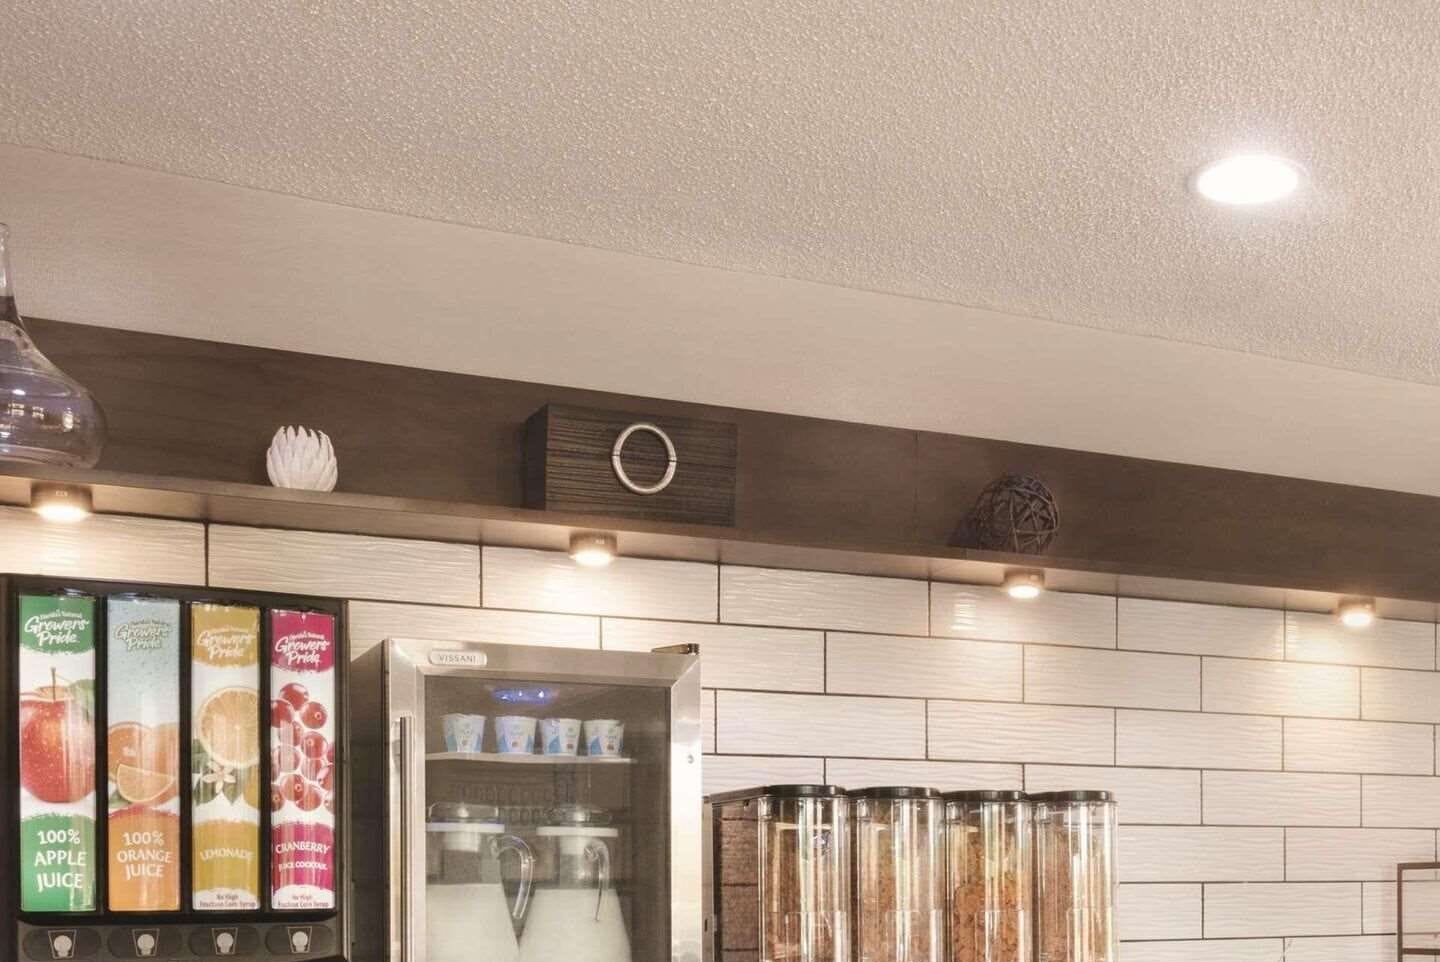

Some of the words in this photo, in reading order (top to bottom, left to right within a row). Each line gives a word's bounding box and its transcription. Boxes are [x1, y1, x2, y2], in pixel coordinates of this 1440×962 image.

[25, 616, 90, 634] Growers
[115, 623, 172, 640] Growers
[37, 631, 80, 646] Pride
[126, 637, 162, 650] Pride
[197, 631, 256, 647] Growers
[275, 635, 330, 652] Growers
[208, 645, 245, 660] Pride
[286, 650, 321, 665] Pride
[438, 653, 476, 664] VISSANI
[37, 829, 81, 845] 100%
[122, 830, 164, 846] 100%
[200, 847, 254, 861] LEMONADE
[275, 841, 330, 855] CRANBERRY
[34, 850, 87, 867] APPLE
[116, 849, 174, 864] ORANGE
[125, 864, 165, 880] JUICE
[36, 872, 84, 893] JUICE
